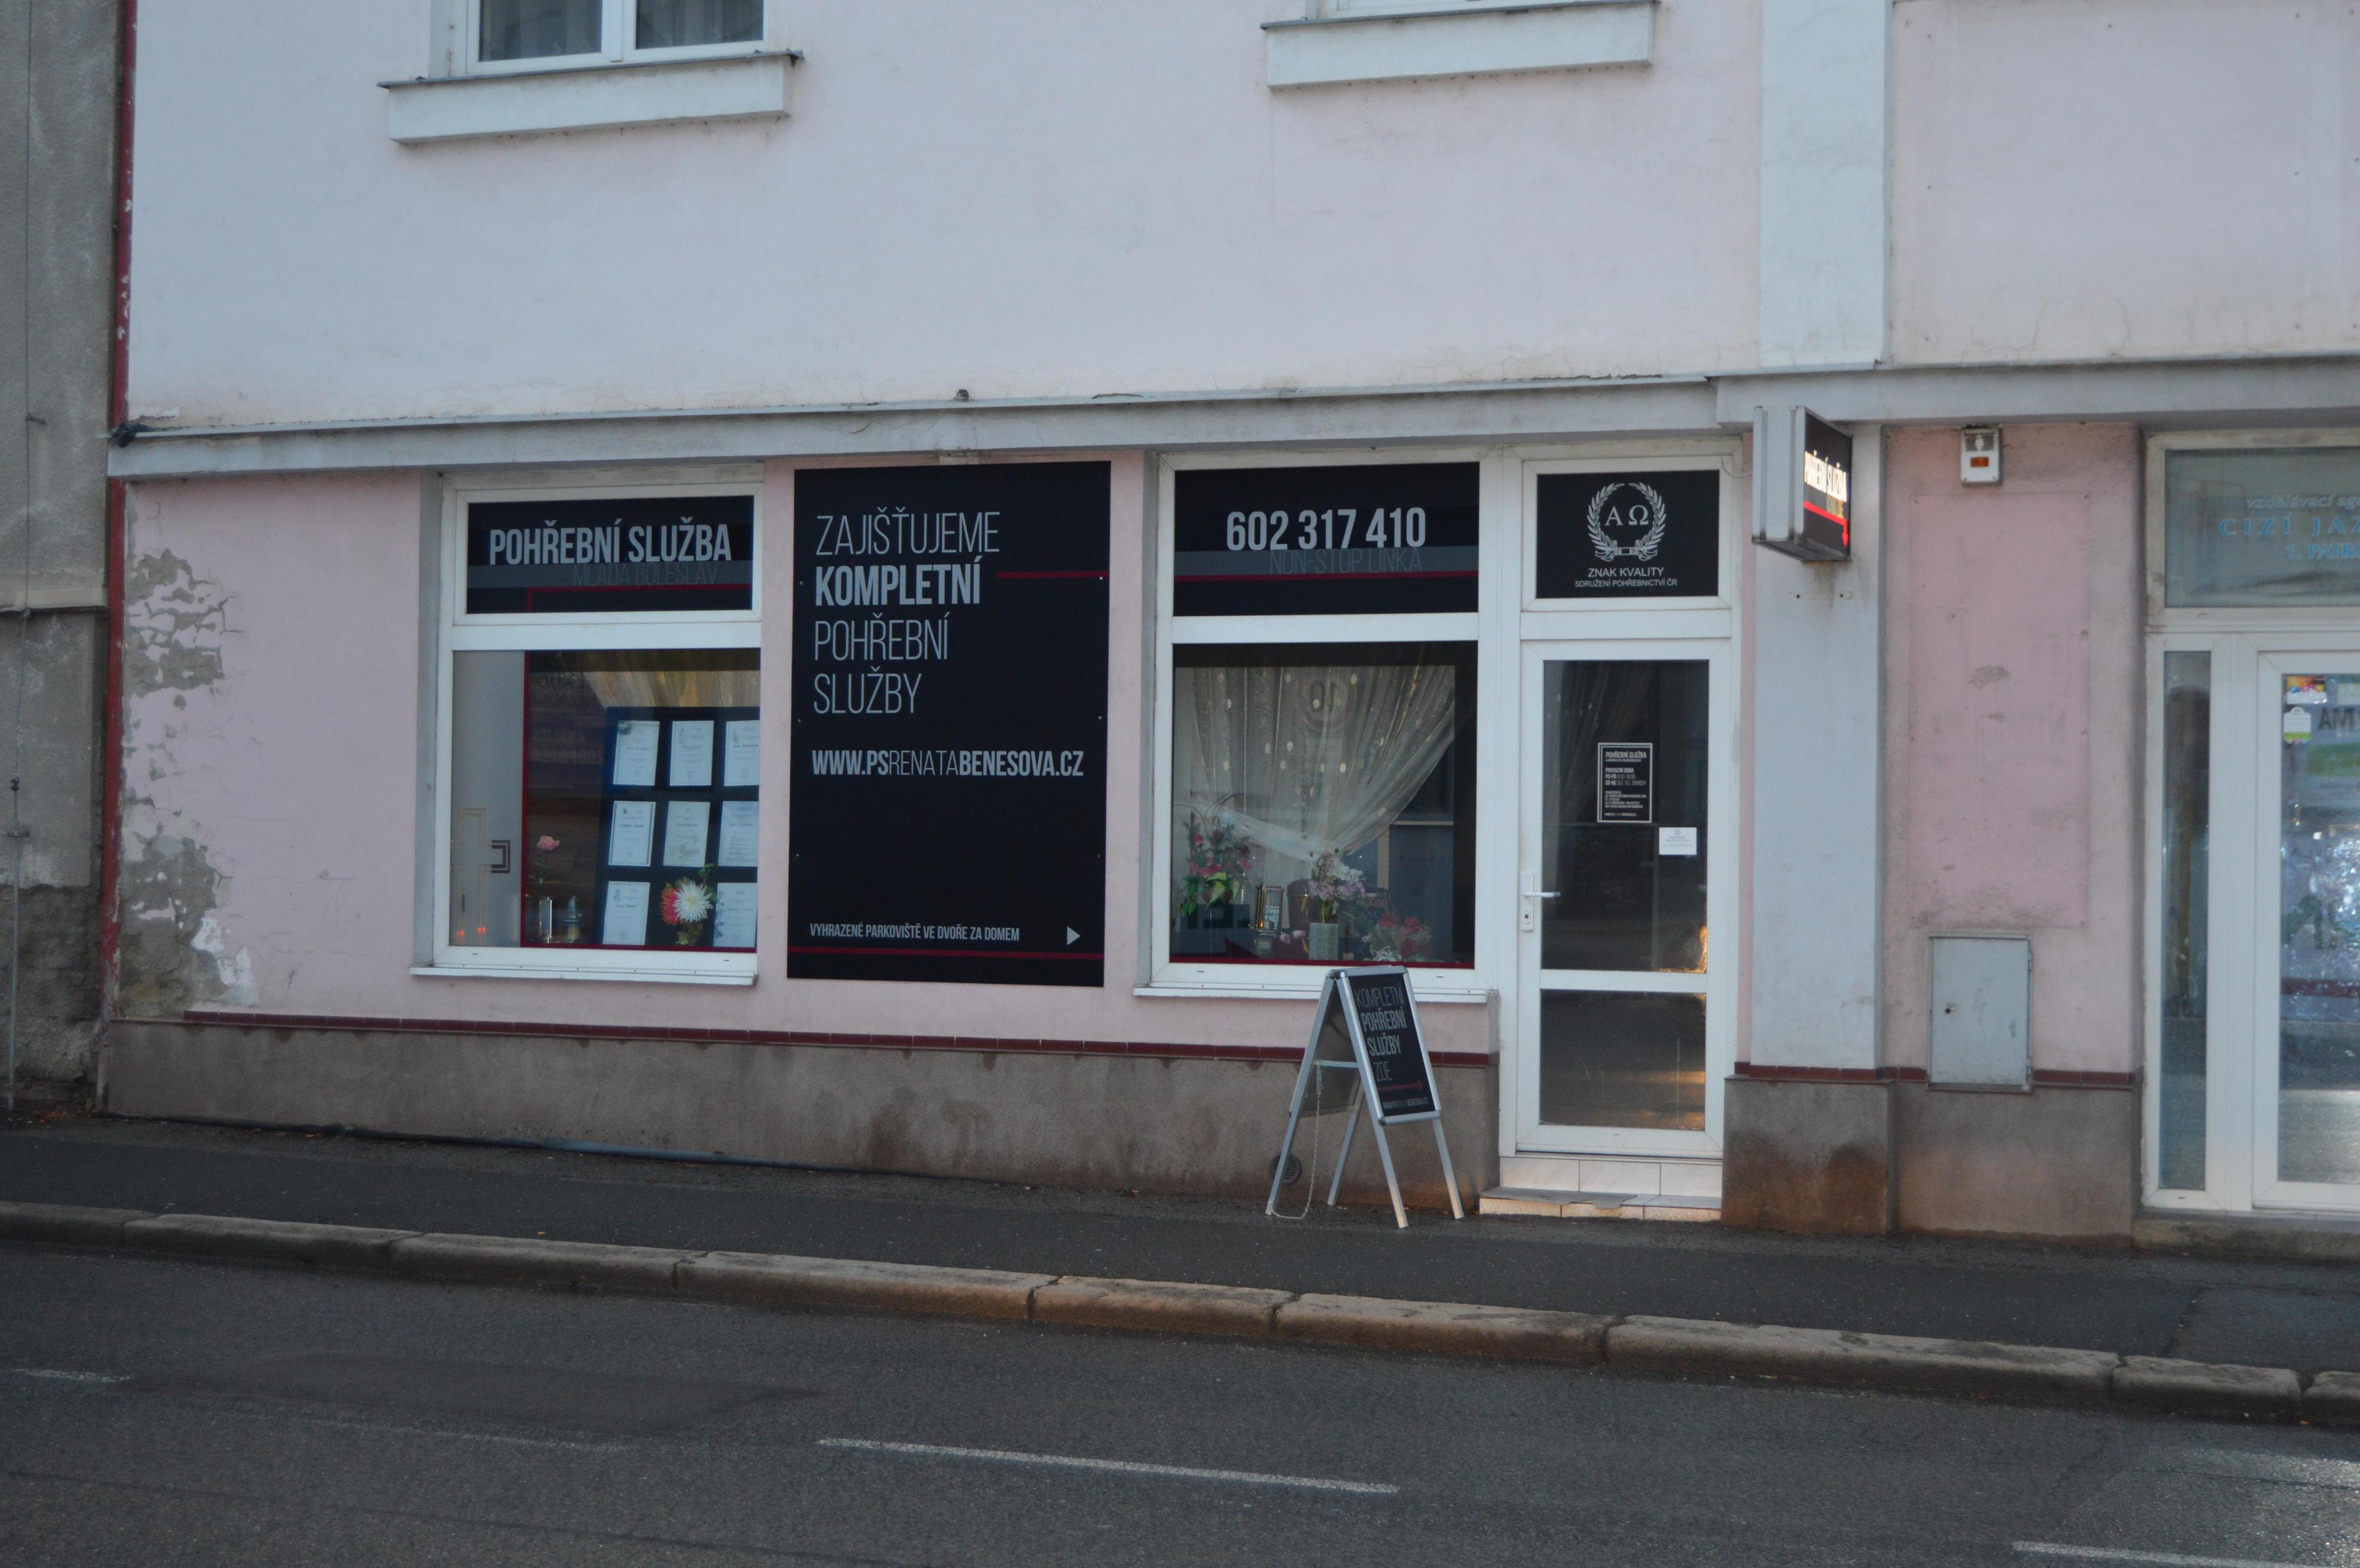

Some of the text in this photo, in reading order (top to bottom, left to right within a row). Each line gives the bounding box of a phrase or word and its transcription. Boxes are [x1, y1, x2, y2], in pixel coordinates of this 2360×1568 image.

[815, 507, 1001, 556] ZAJIŠŤUJEME
[1227, 507, 1426, 551] 602 317 410
[2219, 512, 2293, 537] CIZÍ
[490, 516, 732, 566] POHŘEBNÍ SLUŽBA
[2286, 543, 2303, 559] 1.
[1269, 546, 1423, 575] NON-STOP LINKA
[1588, 567, 1665, 578] ZNAK KVALITY
[635, 561, 718, 586] BOLESLAV
[815, 555, 983, 607] KOMPLETNÍ
[1575, 577, 1678, 588] SDRUŽENÍ POHŘEBNICTVÍ ČR
[814, 611, 950, 660] POHŘEBNÍ
[814, 666, 922, 714] SLUŽBY
[812, 750, 1085, 776] WWW.PSRENATABENESOVA.CZ
[810, 922, 1020, 941] VYHRAZENÉ PARKOVIŠTĚ VE DVOŘE ZA DOMEM
[1354, 983, 1404, 1008] KOMPLETNÍ
[1361, 1006, 1408, 1032] POHŘEBNÍ
[1367, 1032, 1402, 1057] SLUŽBY
[1373, 1061, 1393, 1082] ZDE
